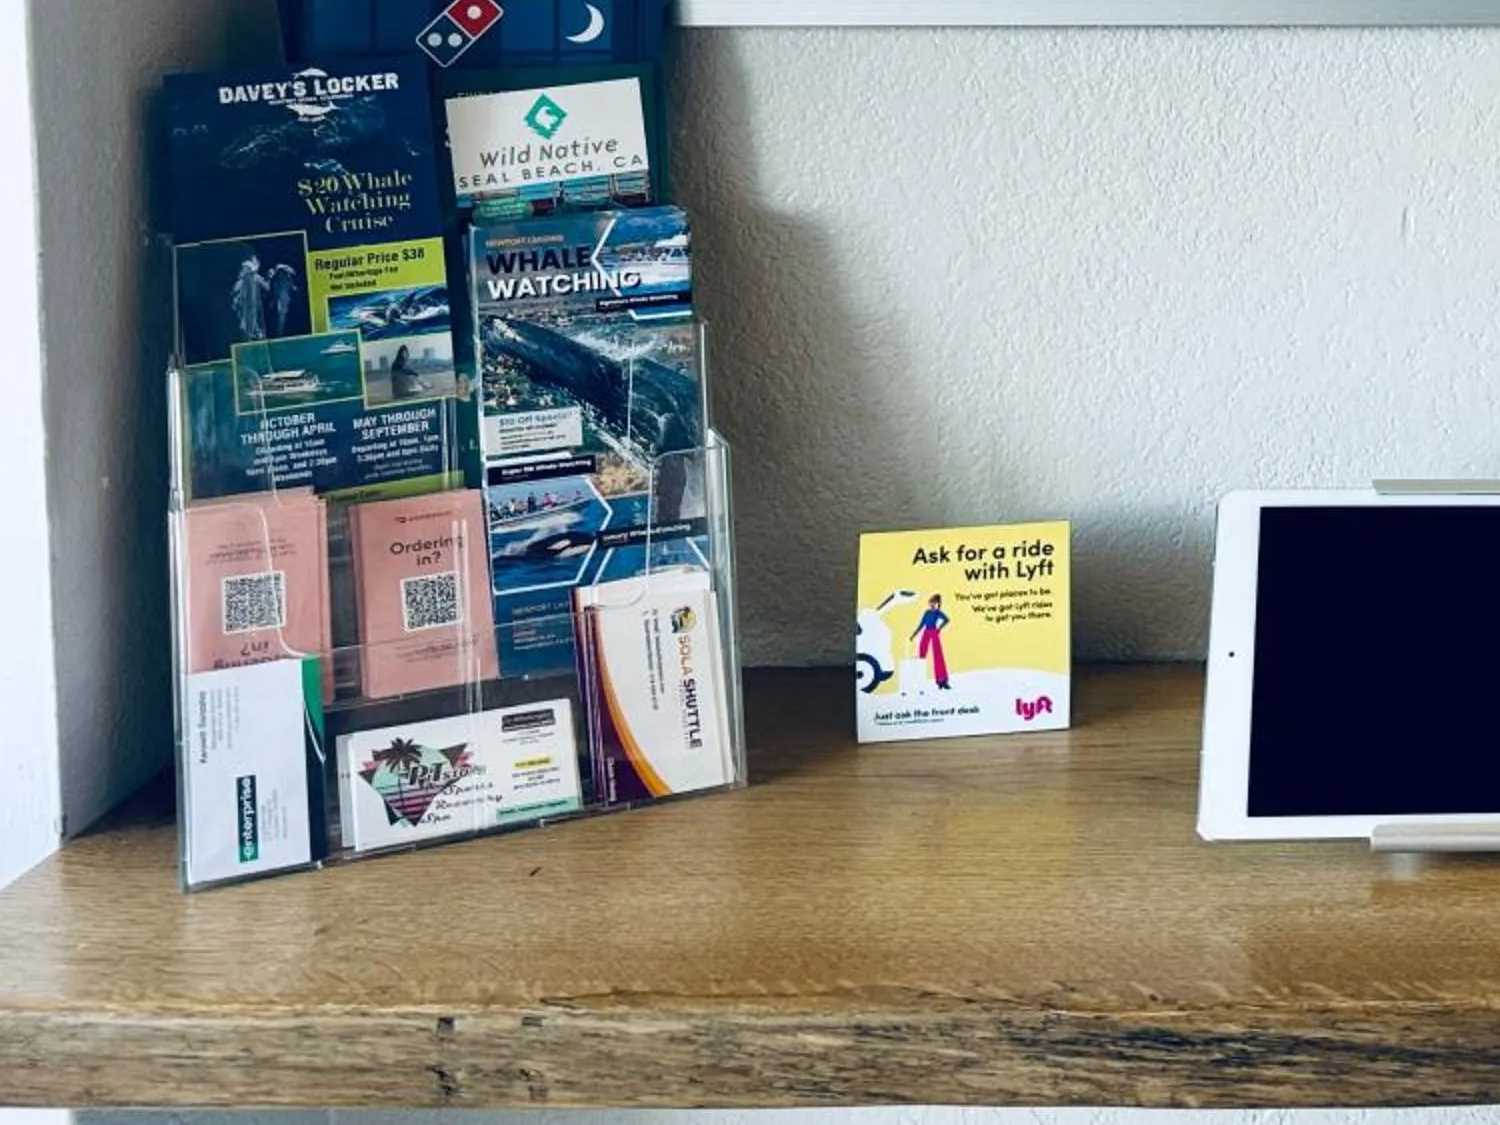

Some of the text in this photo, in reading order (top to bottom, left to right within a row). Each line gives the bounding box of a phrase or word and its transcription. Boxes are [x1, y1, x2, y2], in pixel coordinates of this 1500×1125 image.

[218, 79, 307, 104] DAVEY'S
[313, 72, 400, 96] LOCKER
[479, 135, 619, 169] Wild Native
[297, 169, 413, 196] $20 Whale
[458, 171, 512, 190] SEAL
[613, 154, 644, 168] CA
[305, 190, 412, 216] Watching
[325, 213, 394, 235] Cruise
[315, 256, 364, 273] Regular
[367, 252, 400, 265] Price
[486, 246, 591, 275] WHALE
[487, 271, 642, 301] WATCHING
[353, 408, 437, 430] MAY THROUGH
[361, 421, 429, 441] SEPTEMBER
[240, 421, 337, 445] THROUGH APRIL
[415, 550, 442, 568] in?
[912, 540, 1055, 565] Ask for a ride
[964, 560, 1054, 582] with Lyft
[677, 635, 703, 749] SOLA SHUTTLE
[874, 712, 893, 722] Just
[894, 711, 911, 721] ask
[913, 709, 929, 719] the
[931, 707, 955, 717] front
[1014, 696, 1053, 721] lyft
[241, 776, 255, 859] enterprise
